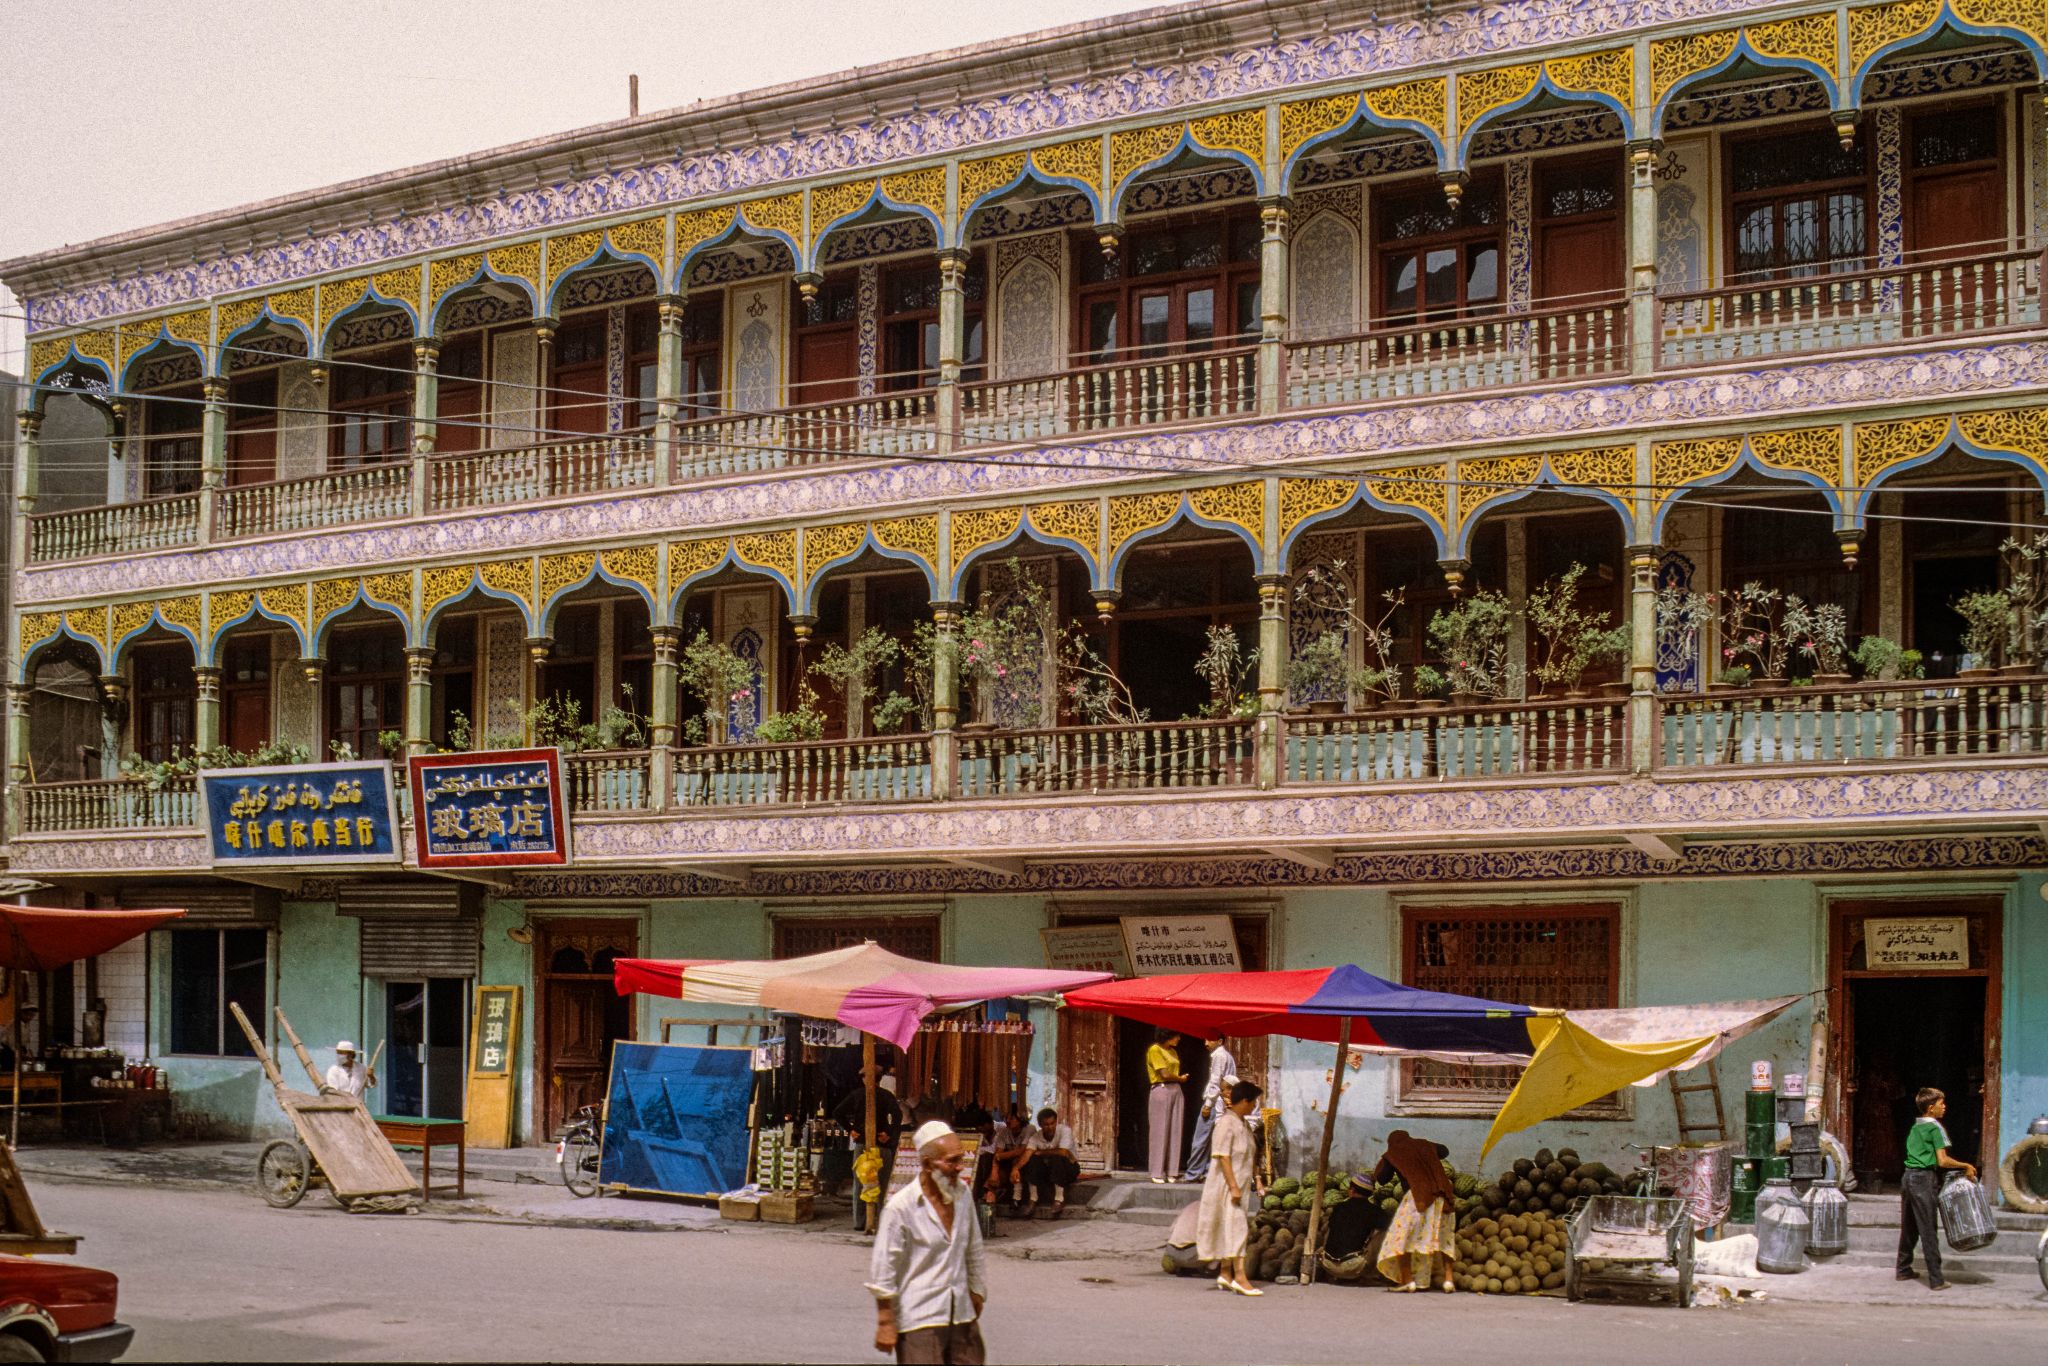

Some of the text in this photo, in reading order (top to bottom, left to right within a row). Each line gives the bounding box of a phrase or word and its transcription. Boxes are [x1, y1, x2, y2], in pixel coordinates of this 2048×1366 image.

[431, 800, 546, 839] 玻璃店
[1140, 925, 1170, 937] 喀什市
[483, 997, 506, 1067] 玻璃店
